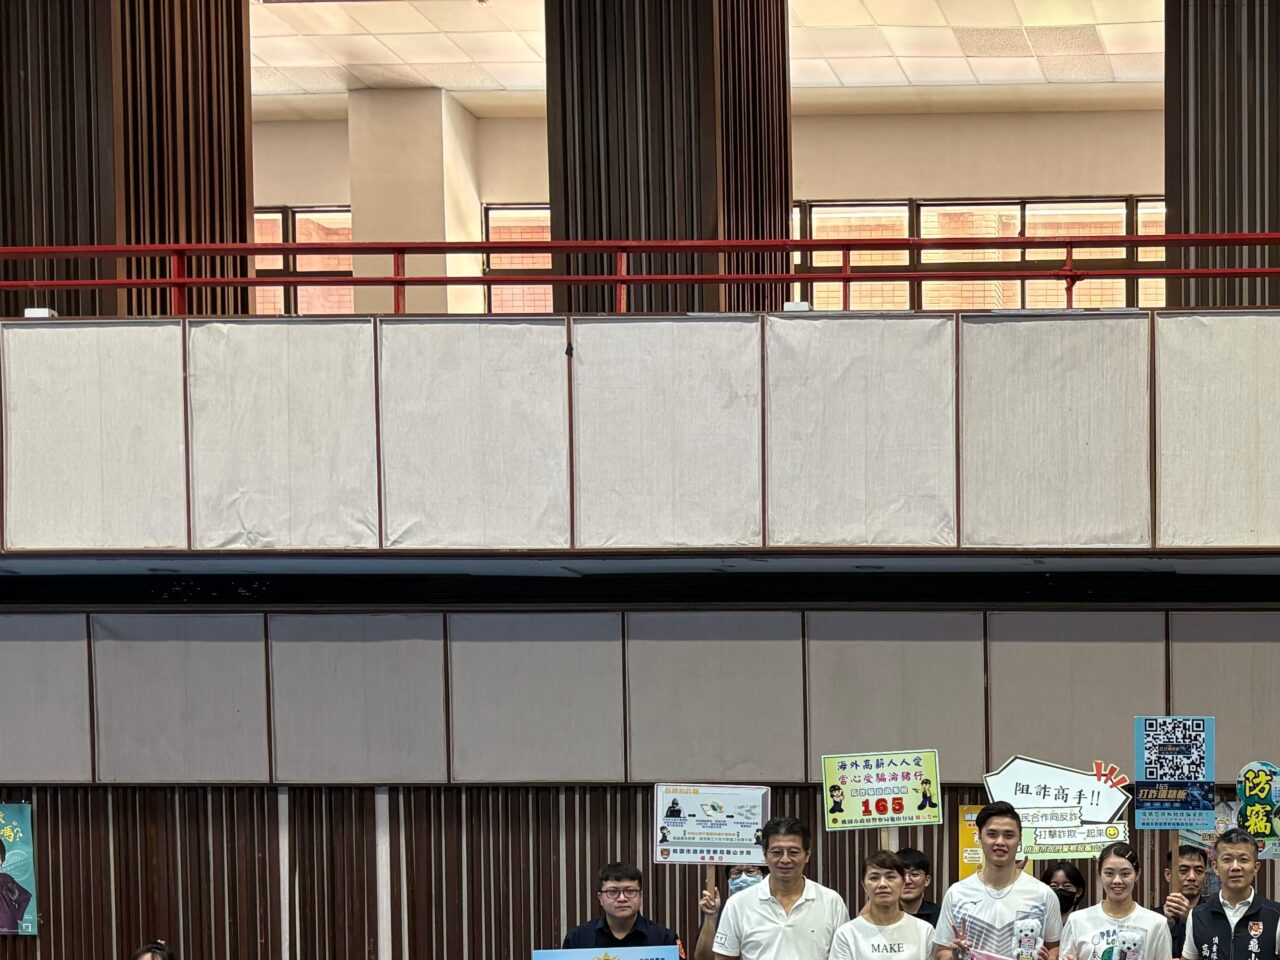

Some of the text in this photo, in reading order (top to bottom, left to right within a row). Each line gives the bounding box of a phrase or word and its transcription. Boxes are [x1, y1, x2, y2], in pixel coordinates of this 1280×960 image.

[1015, 782, 1101, 806] 阻詐高手!!
[862, 797, 904, 816] 165
[1020, 812, 1079, 822] 民合作同反詐
[871, 943, 905, 954] MAKE
